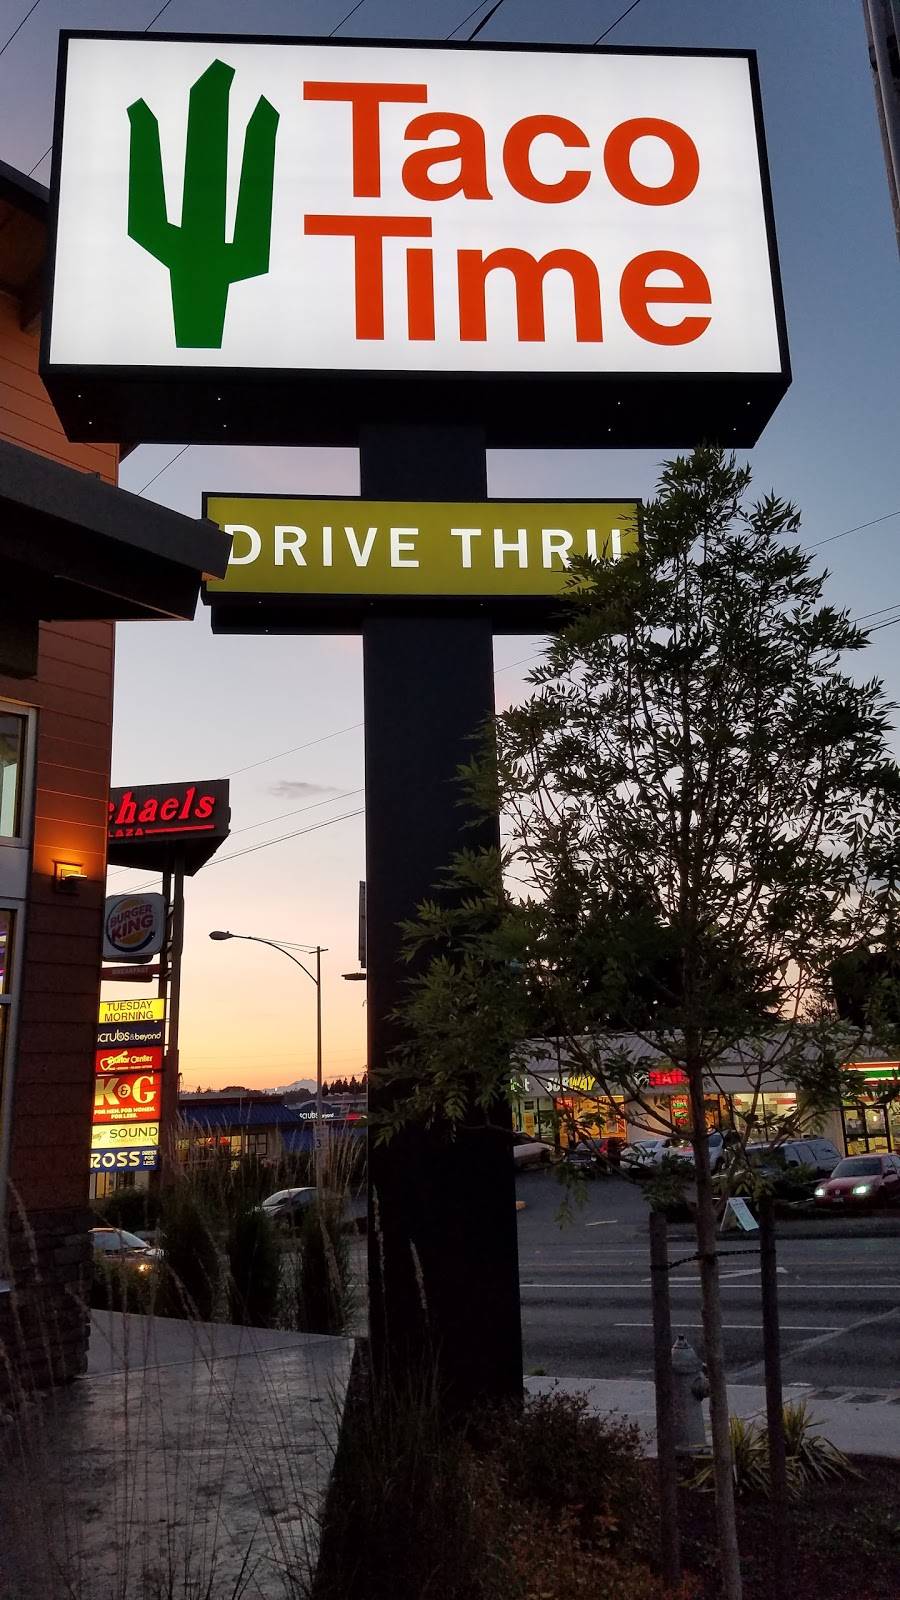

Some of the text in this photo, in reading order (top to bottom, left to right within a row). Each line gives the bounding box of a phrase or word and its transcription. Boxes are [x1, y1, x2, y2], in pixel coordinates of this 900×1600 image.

[303, 81, 701, 207] Taco
[303, 214, 713, 347] Time
[224, 524, 420, 568] DRIVE
[110, 903, 153, 928] BURGER
[112, 914, 154, 940] KING
[104, 1011, 154, 1021] MORNING
[107, 1001, 152, 1011] TUESDAY
[109, 1126, 157, 1138] SOUND
[90, 1151, 140, 1168] ROSS
